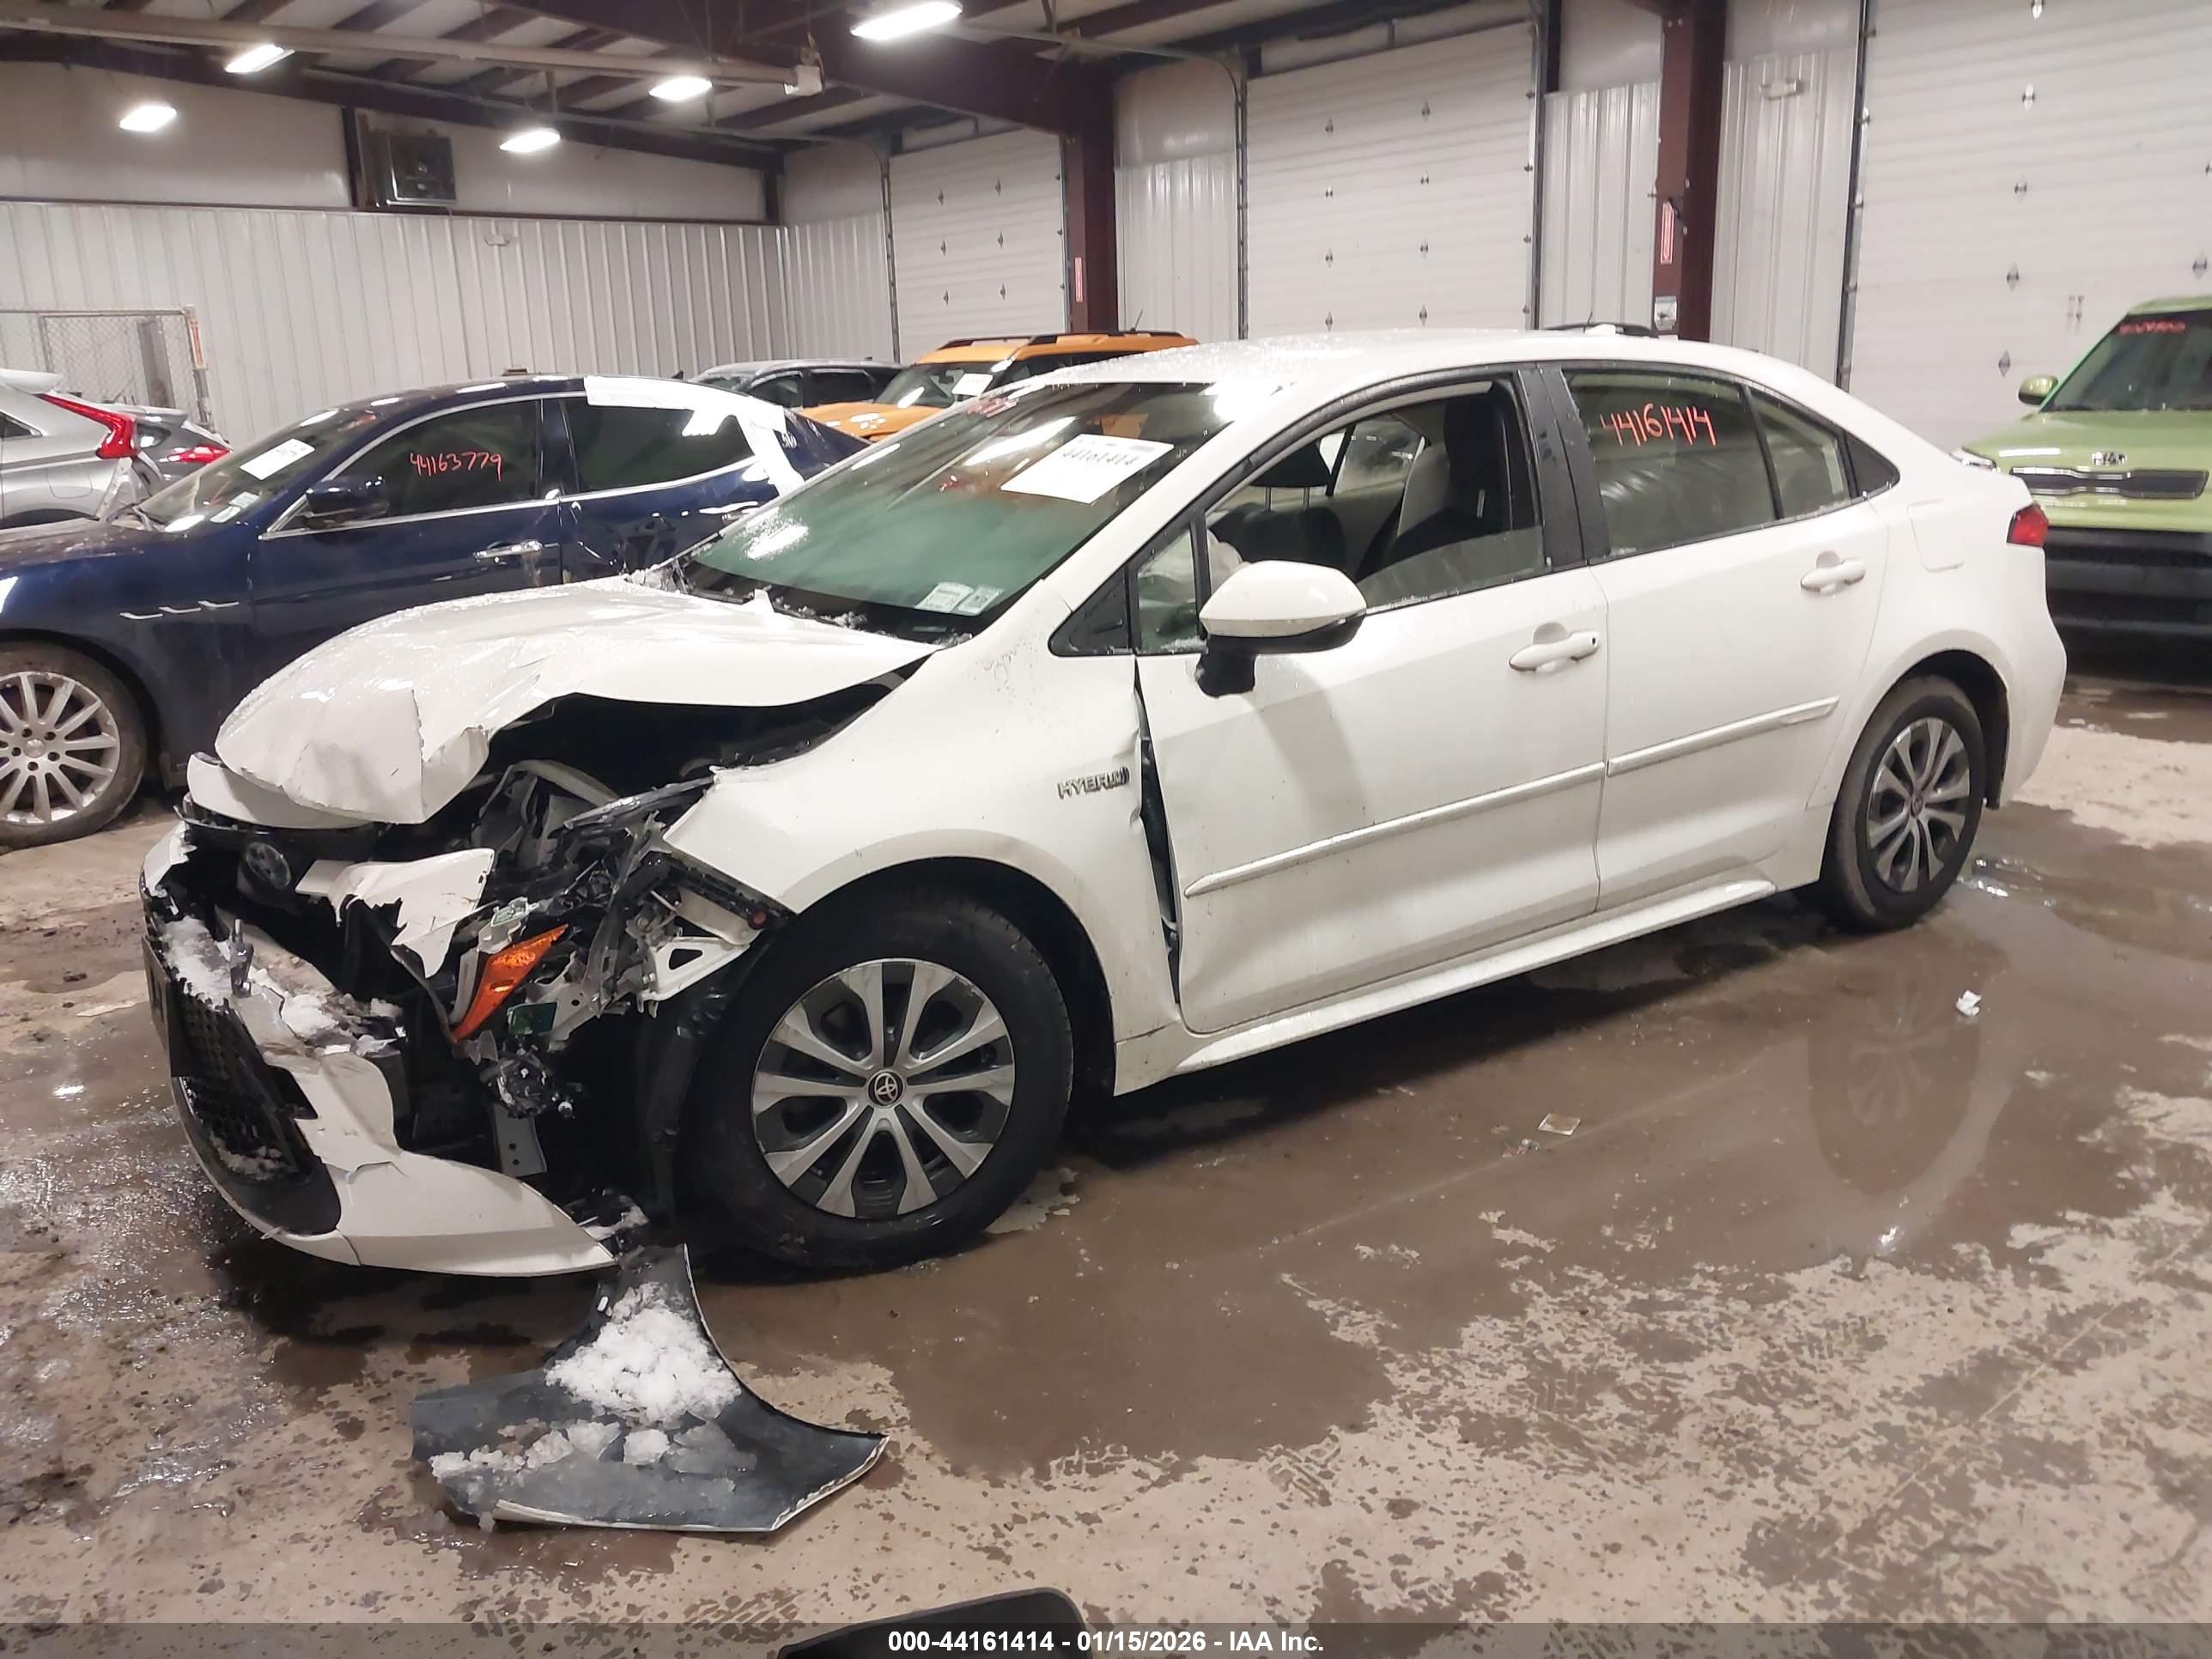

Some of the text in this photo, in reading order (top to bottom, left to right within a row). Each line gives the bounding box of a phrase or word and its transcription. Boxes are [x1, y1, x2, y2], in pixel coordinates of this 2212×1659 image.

[1600, 403, 1717, 447] 44161414
[410, 452, 502, 481] 44163779
[1056, 766, 1131, 799] HYBRID
